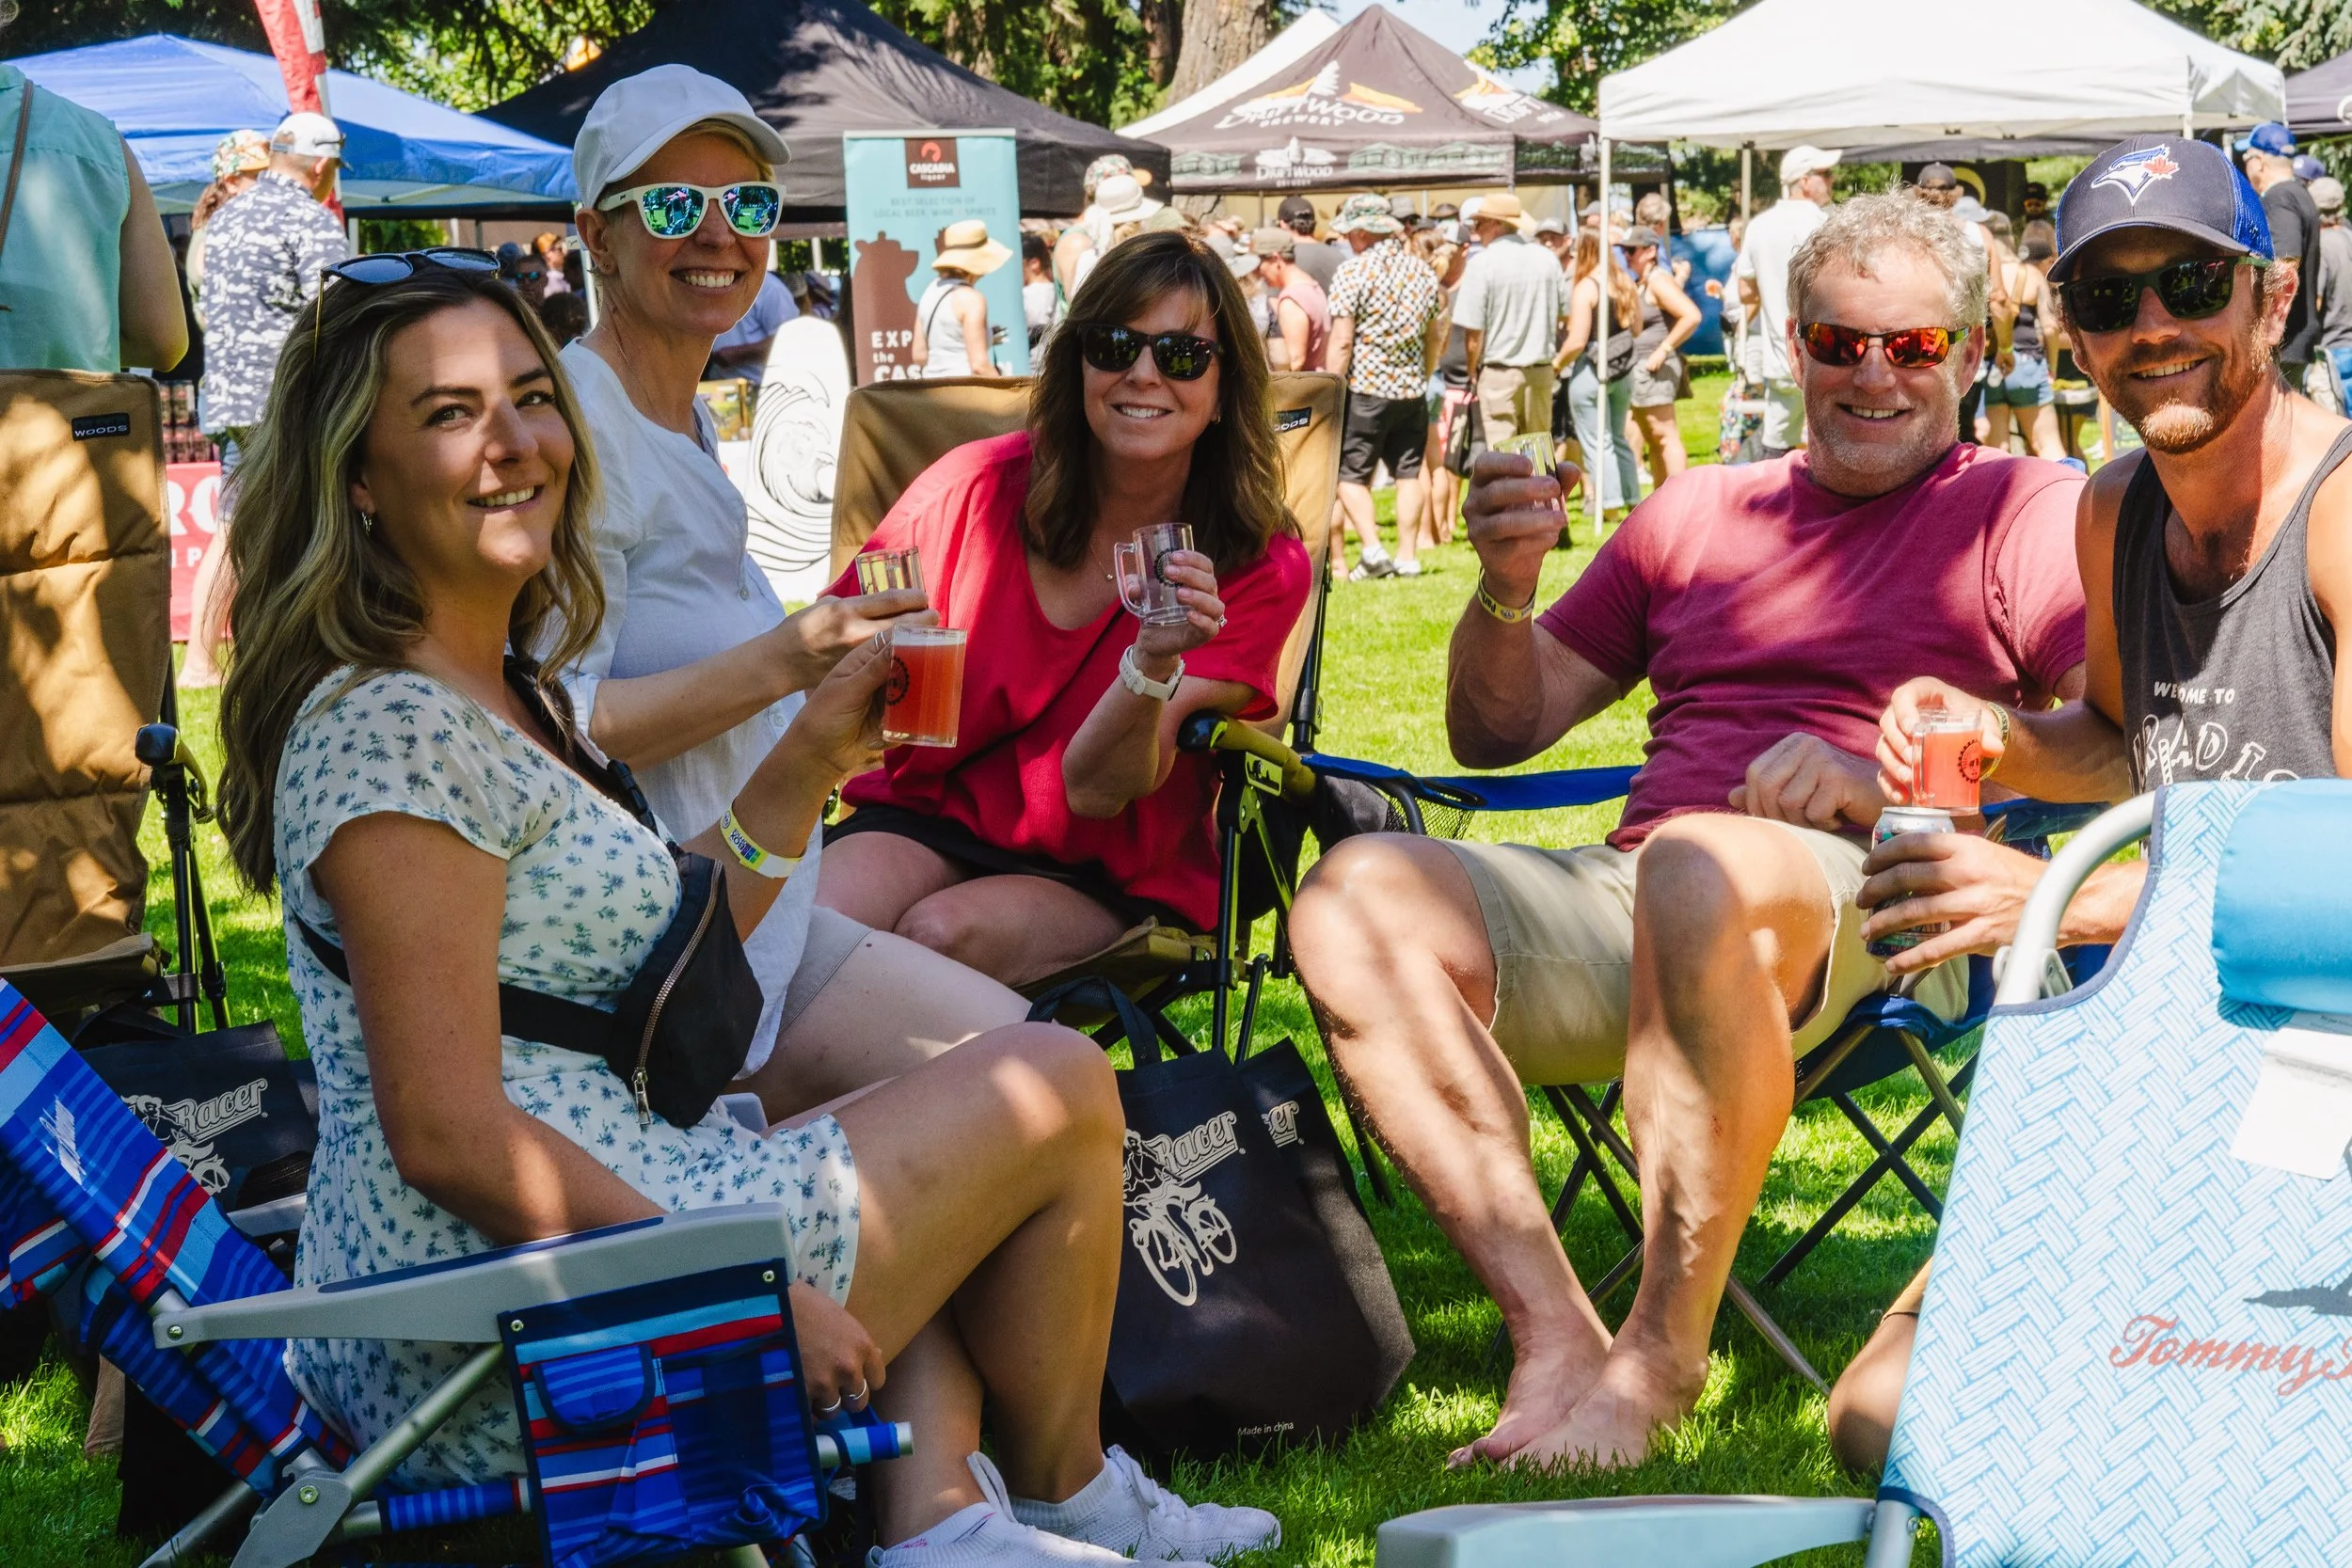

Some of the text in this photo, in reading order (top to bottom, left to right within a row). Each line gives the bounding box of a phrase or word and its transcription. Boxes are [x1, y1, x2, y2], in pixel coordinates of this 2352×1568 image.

[871, 330, 914, 349] EXP
[873, 351, 895, 364] the
[74, 424, 128, 436] WOODS
[2214, 688, 2235, 704] TO
[164, 1078, 268, 1136] Racer
[1141, 1111, 1237, 1175] Racer
[2109, 1314, 2317, 1397] Tommy
[1237, 1426, 1262, 1435] Made
[1263, 1424, 1272, 1433] in
